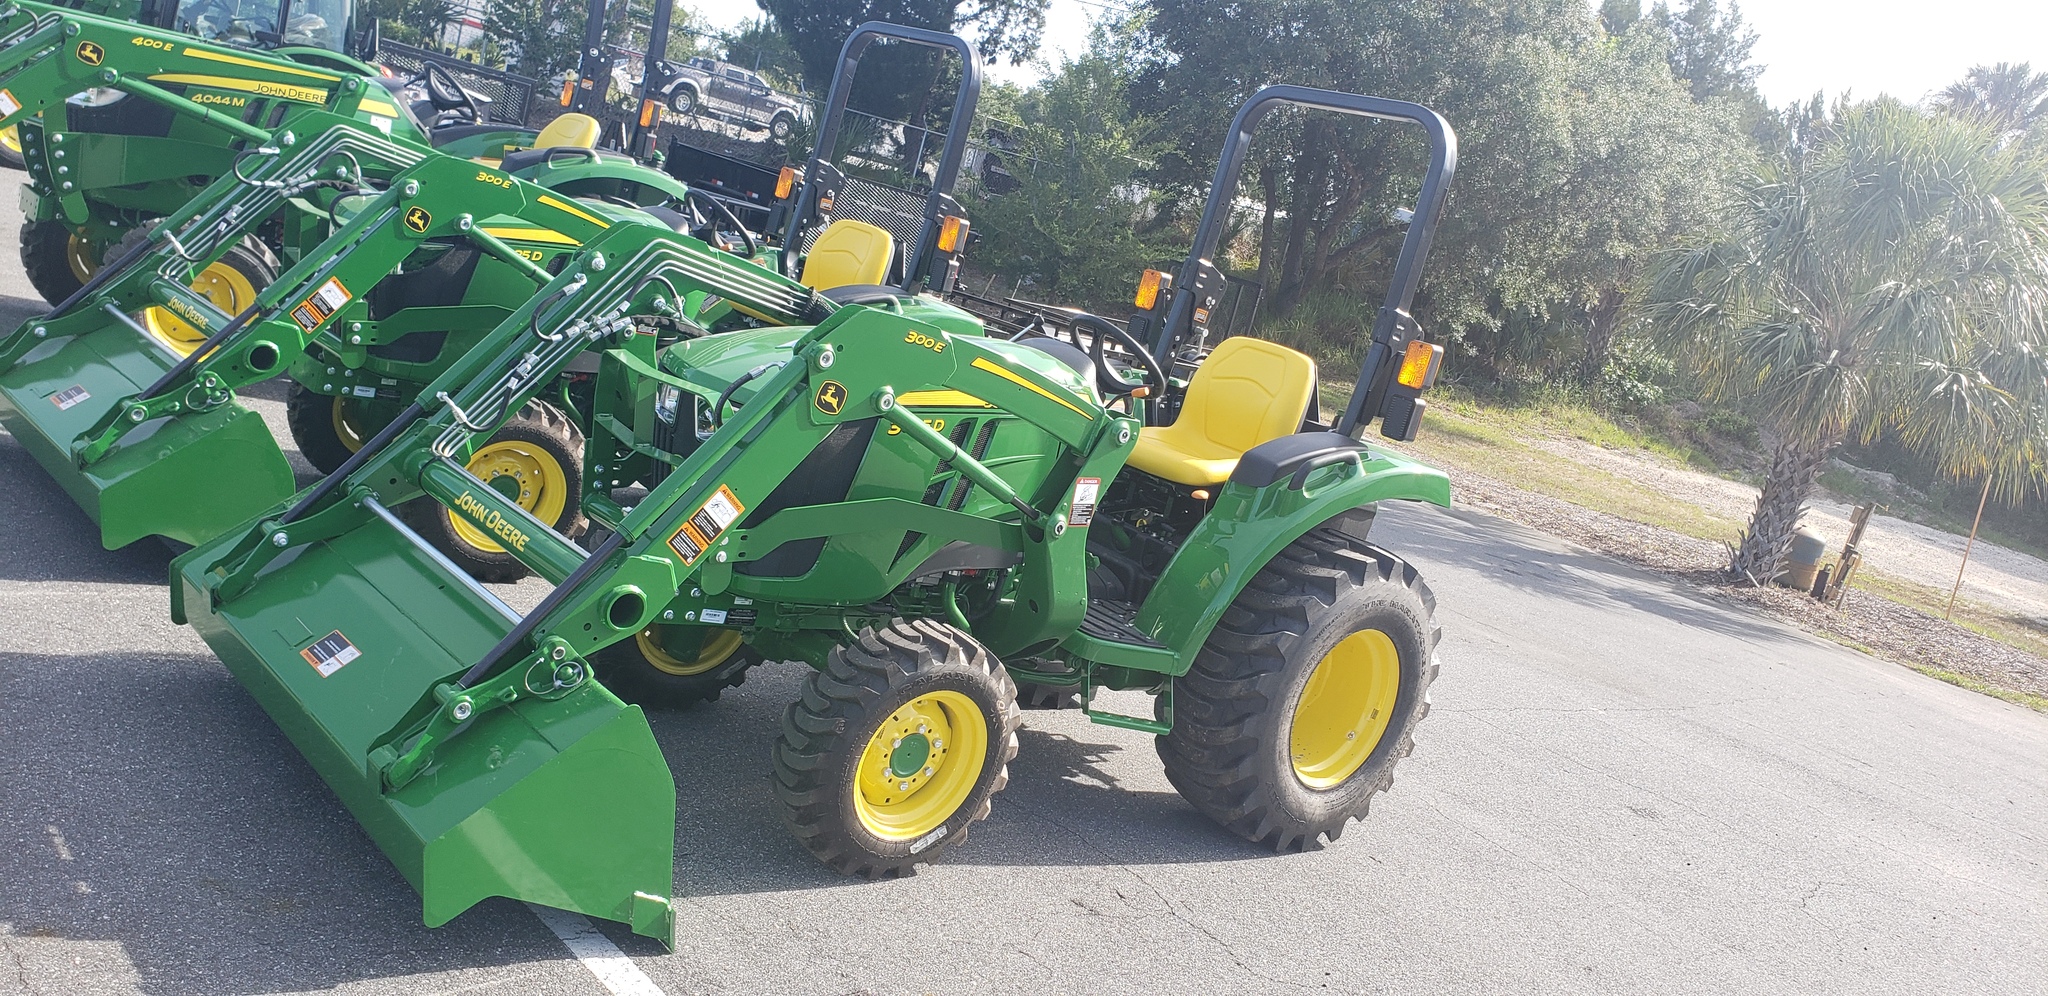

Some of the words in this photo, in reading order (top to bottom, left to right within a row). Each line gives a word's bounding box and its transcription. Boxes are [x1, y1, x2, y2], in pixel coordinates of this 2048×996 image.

[252, 82, 288, 98] JOHN
[288, 88, 328, 104] DEERE
[167, 295, 188, 316] JOHN
[185, 305, 210, 330] DEERE
[454, 490, 490, 523] JOHN
[485, 510, 531, 552] DEERE
